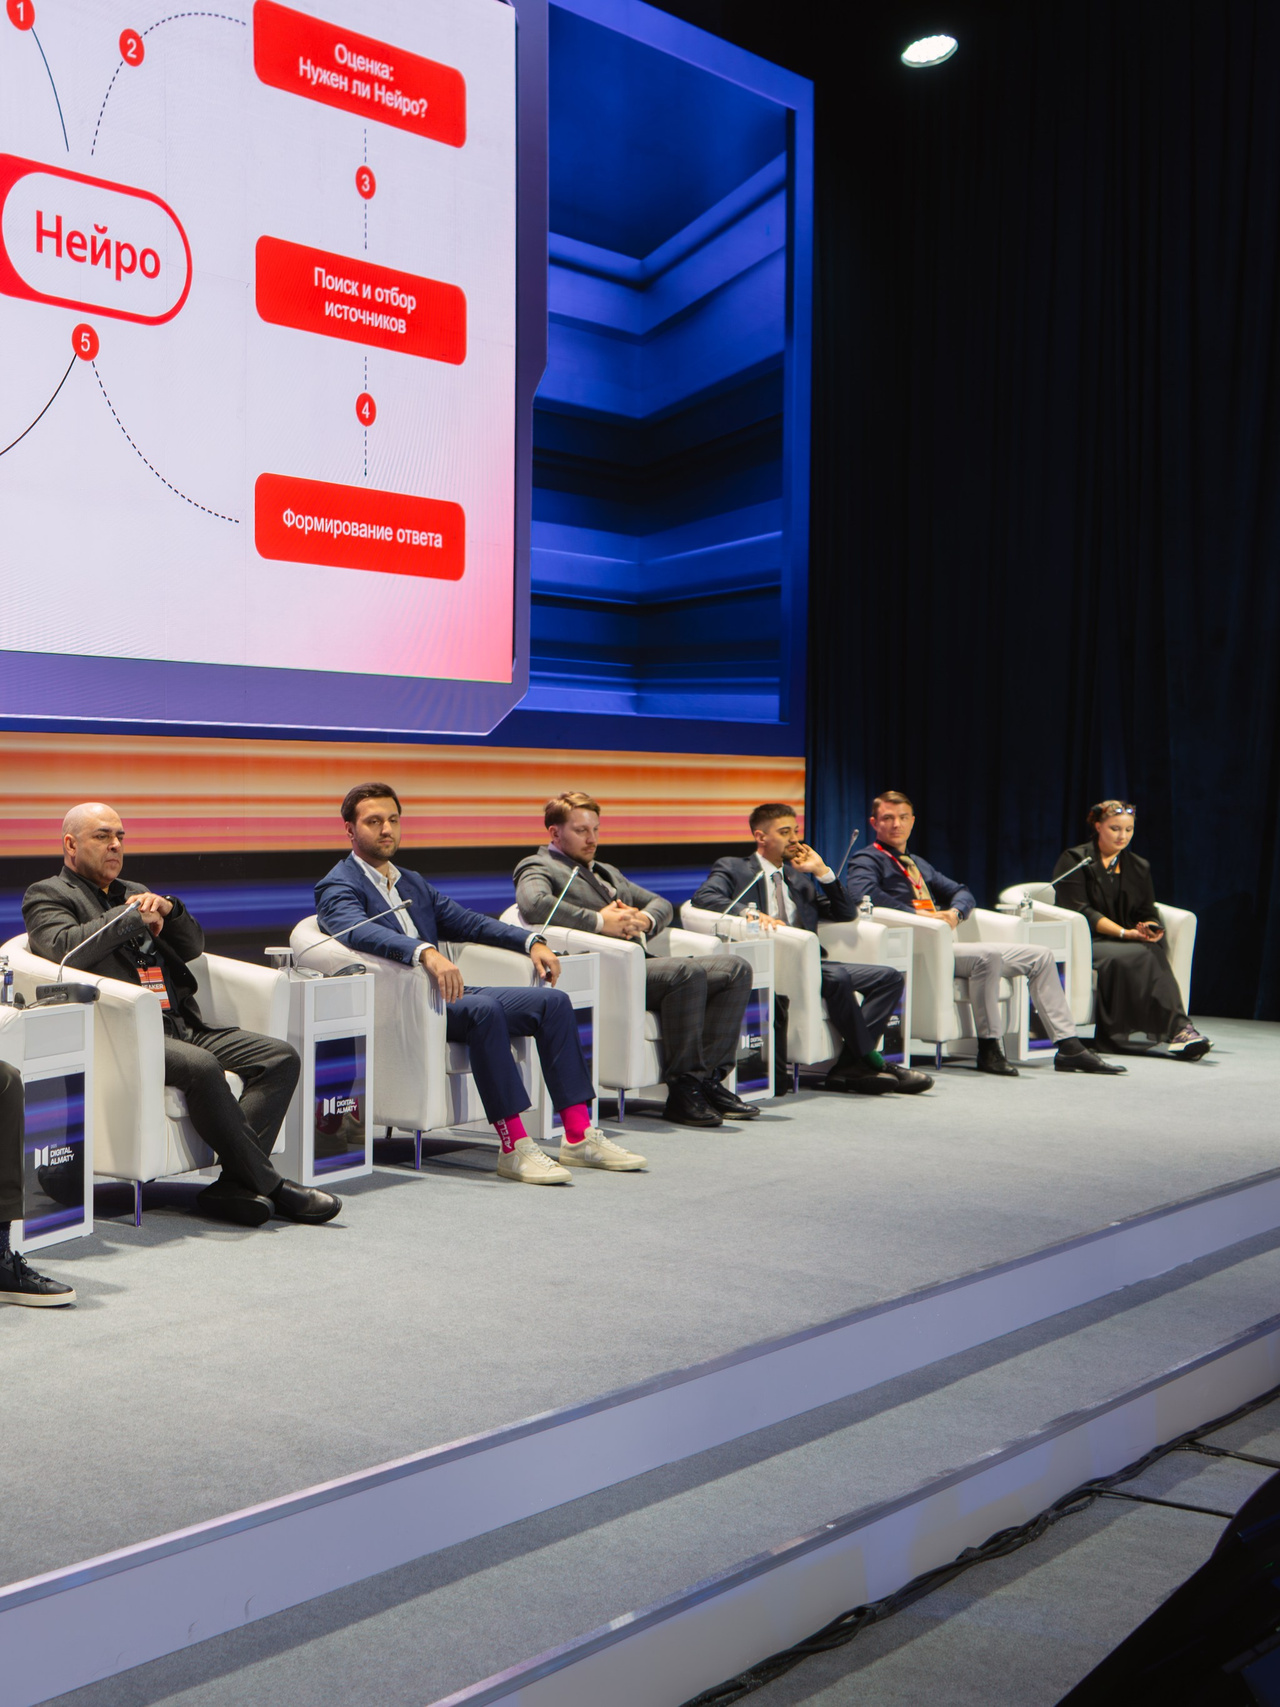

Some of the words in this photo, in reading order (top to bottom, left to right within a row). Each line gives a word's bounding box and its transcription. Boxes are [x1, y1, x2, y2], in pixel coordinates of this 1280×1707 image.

[17, 3, 24, 22] 1
[127, 38, 137, 58] 2
[334, 43, 394, 81] Оценка:
[299, 56, 348, 92] Нужен
[351, 79, 370, 99] ли
[374, 82, 428, 118] Нейро?
[361, 174, 370, 192] 3
[36, 210, 161, 281] Нейро
[314, 266, 358, 297] Поиск
[362, 284, 371, 299] и
[375, 286, 416, 314] отбор
[324, 300, 407, 334] источников
[80, 332, 91, 352] 5
[361, 400, 370, 419] 4
[282, 508, 393, 542] Формирование
[396, 528, 443, 549] ответа
[50, 1146, 73, 1158] DIGITAL
[50, 1153, 75, 1166] ALMATY
